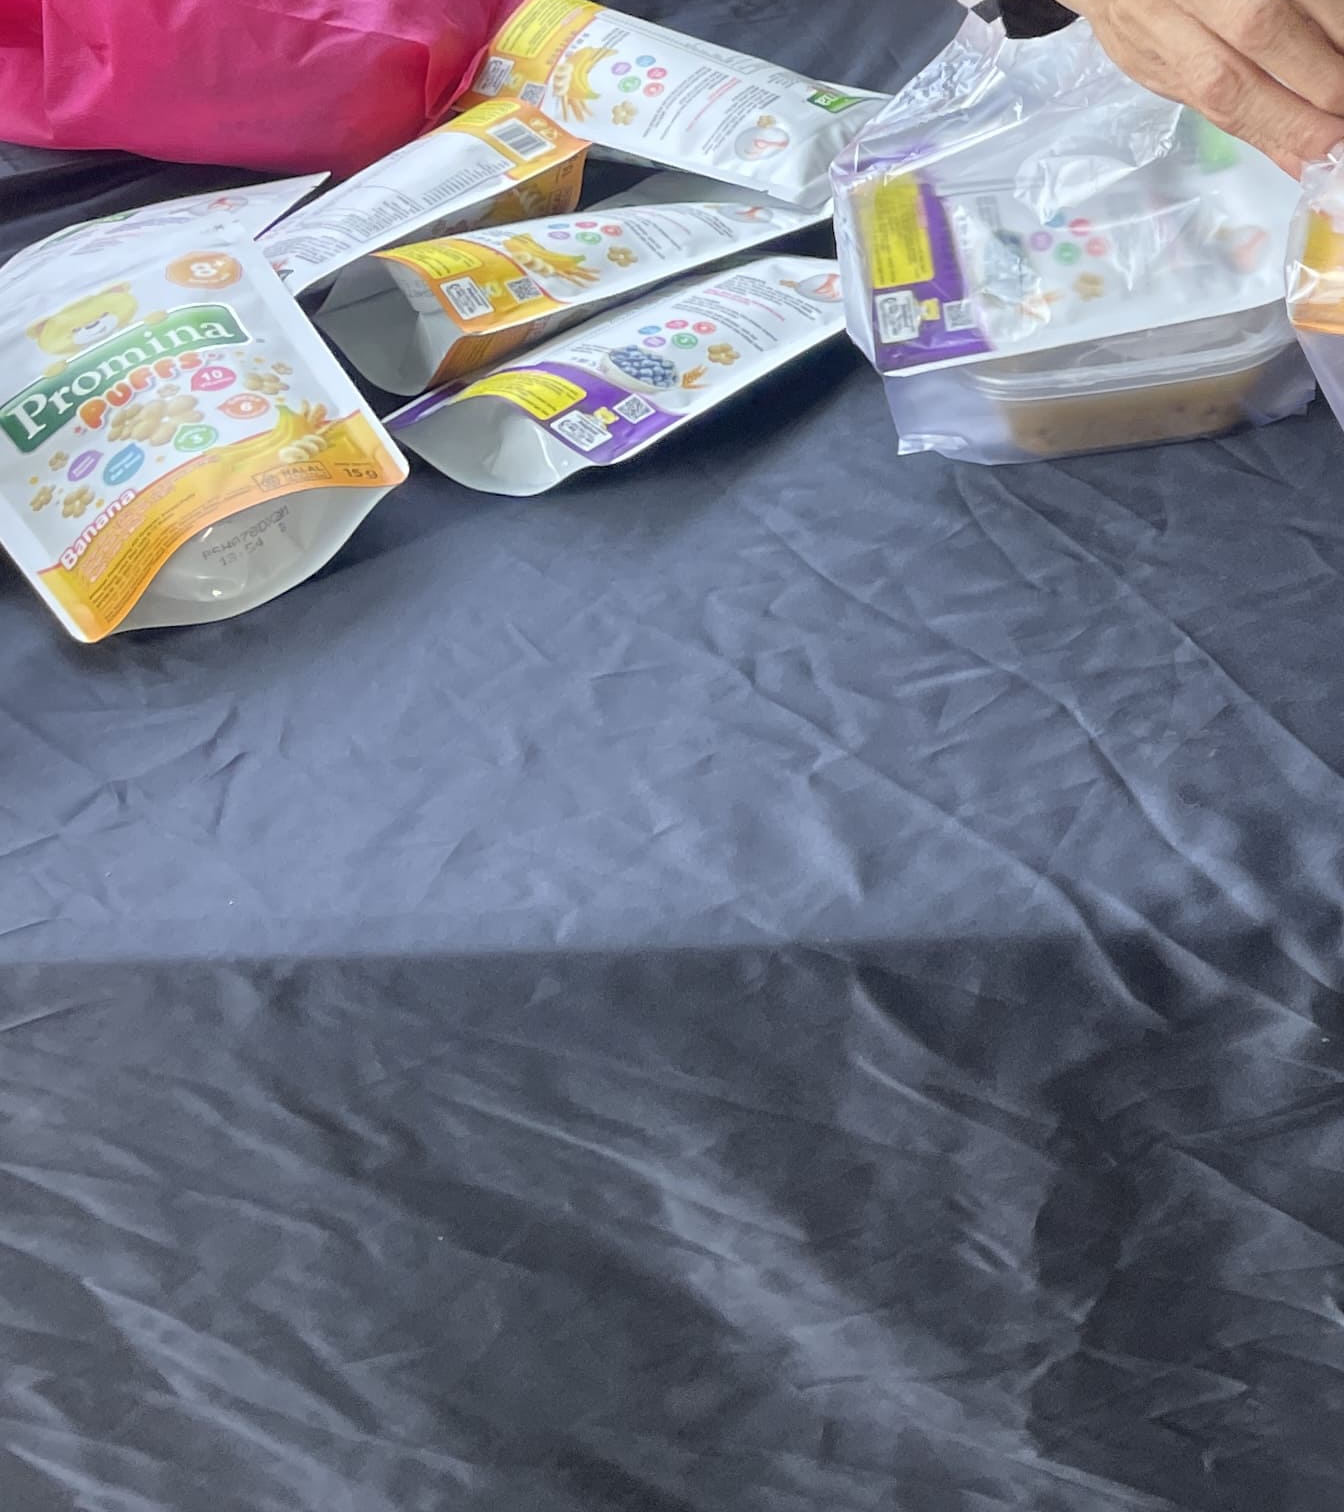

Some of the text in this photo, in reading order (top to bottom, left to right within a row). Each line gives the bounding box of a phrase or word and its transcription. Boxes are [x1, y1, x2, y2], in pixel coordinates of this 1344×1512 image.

[6, 320, 235, 440] Promina
[201, 368, 224, 382] 10
[343, 467, 362, 479] 15
[60, 488, 137, 571] Banana
